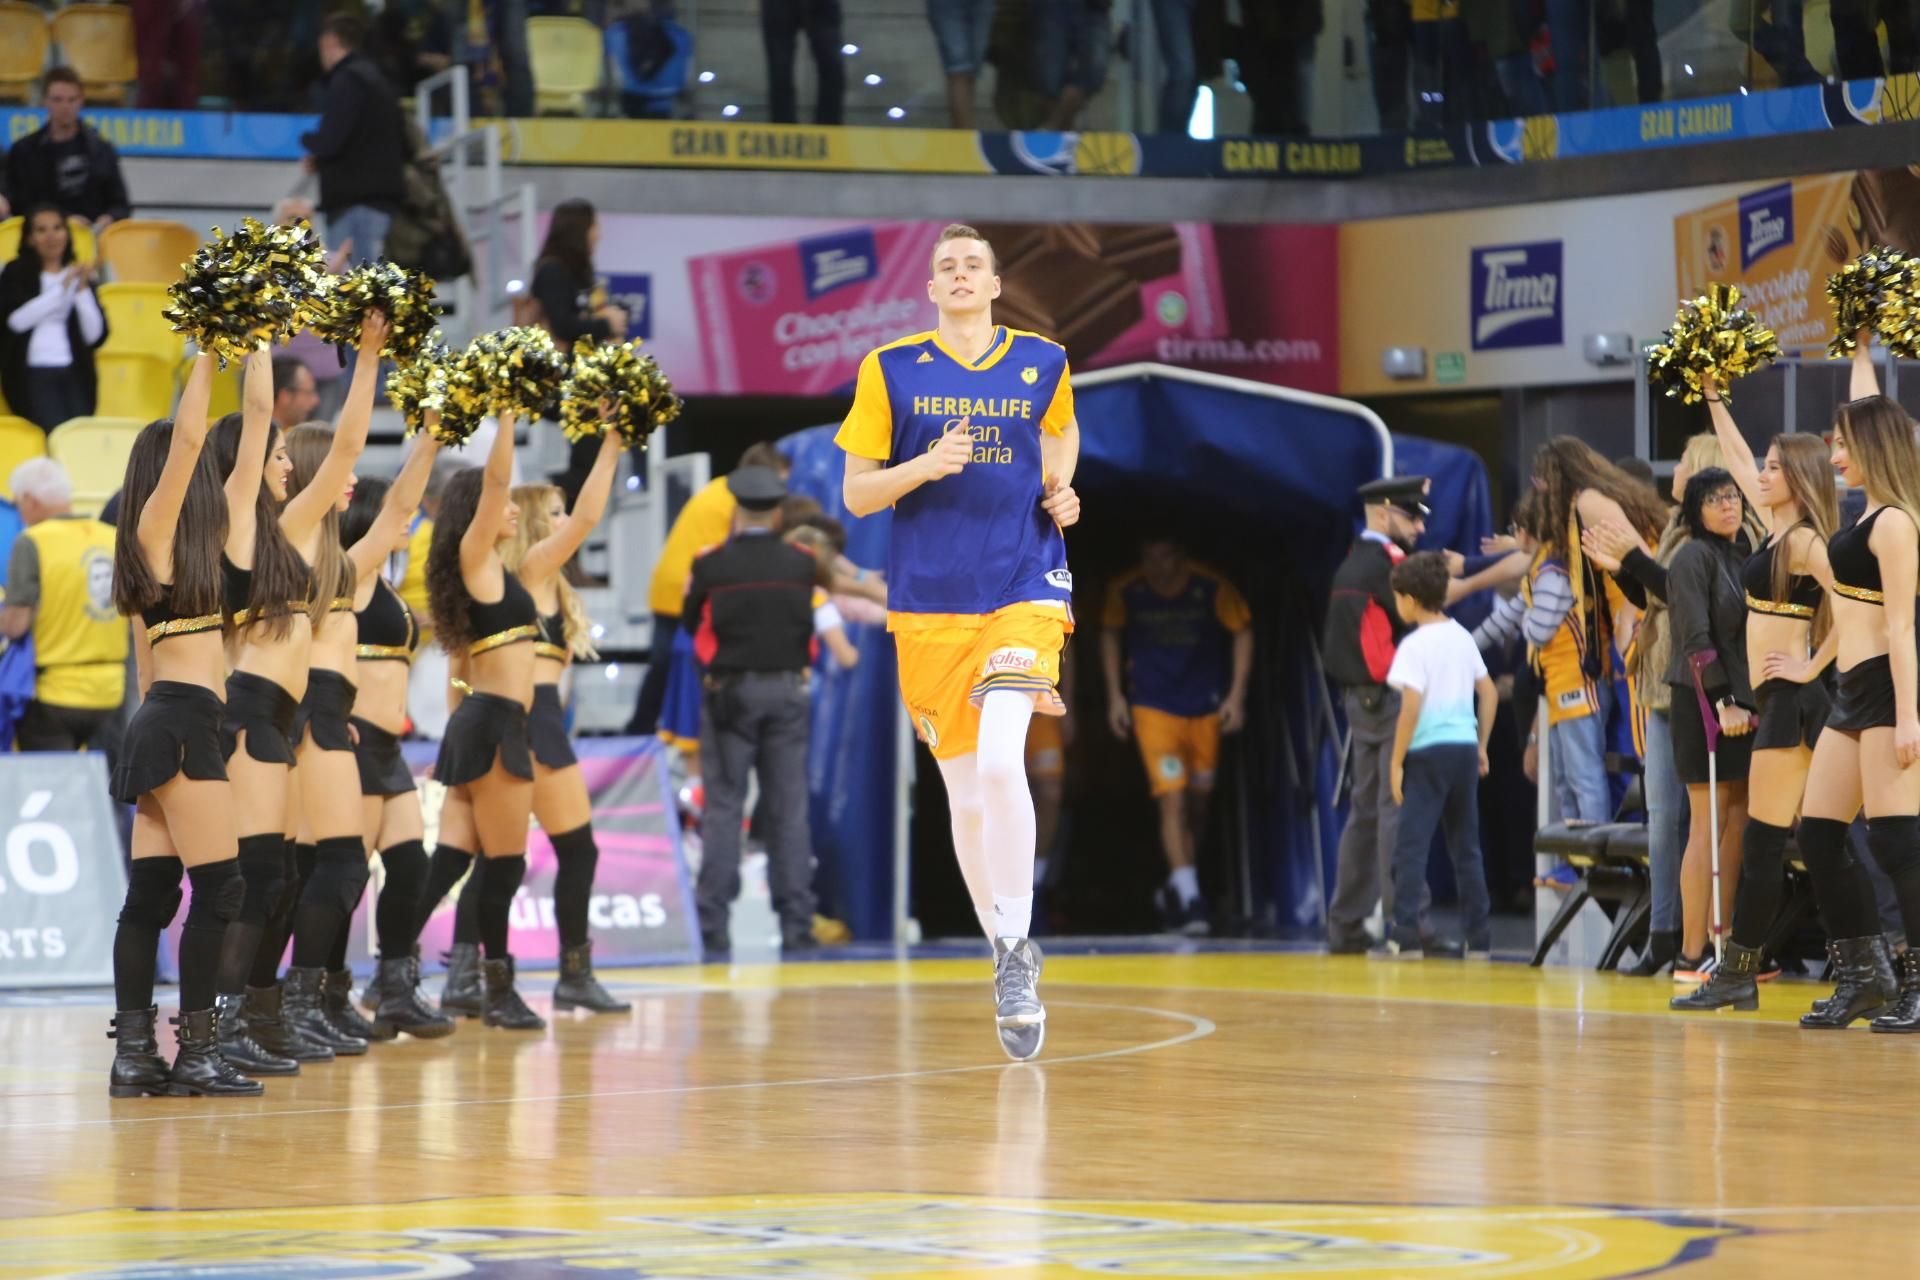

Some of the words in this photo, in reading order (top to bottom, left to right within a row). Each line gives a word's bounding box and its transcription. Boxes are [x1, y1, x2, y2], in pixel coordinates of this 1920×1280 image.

[1641, 108, 1674, 141] GRAN
[1679, 102, 1732, 138] CANARIA
[672, 129, 727, 156] GRAN
[738, 130, 829, 160] CANARIA
[1223, 141, 1279, 171] GRAN
[1481, 250, 1557, 312] Tirma
[773, 297, 919, 345] Chocolate
[785, 340, 840, 371] con
[1156, 334, 1321, 361] tirma.com
[914, 396, 1032, 419] HERBALIFE
